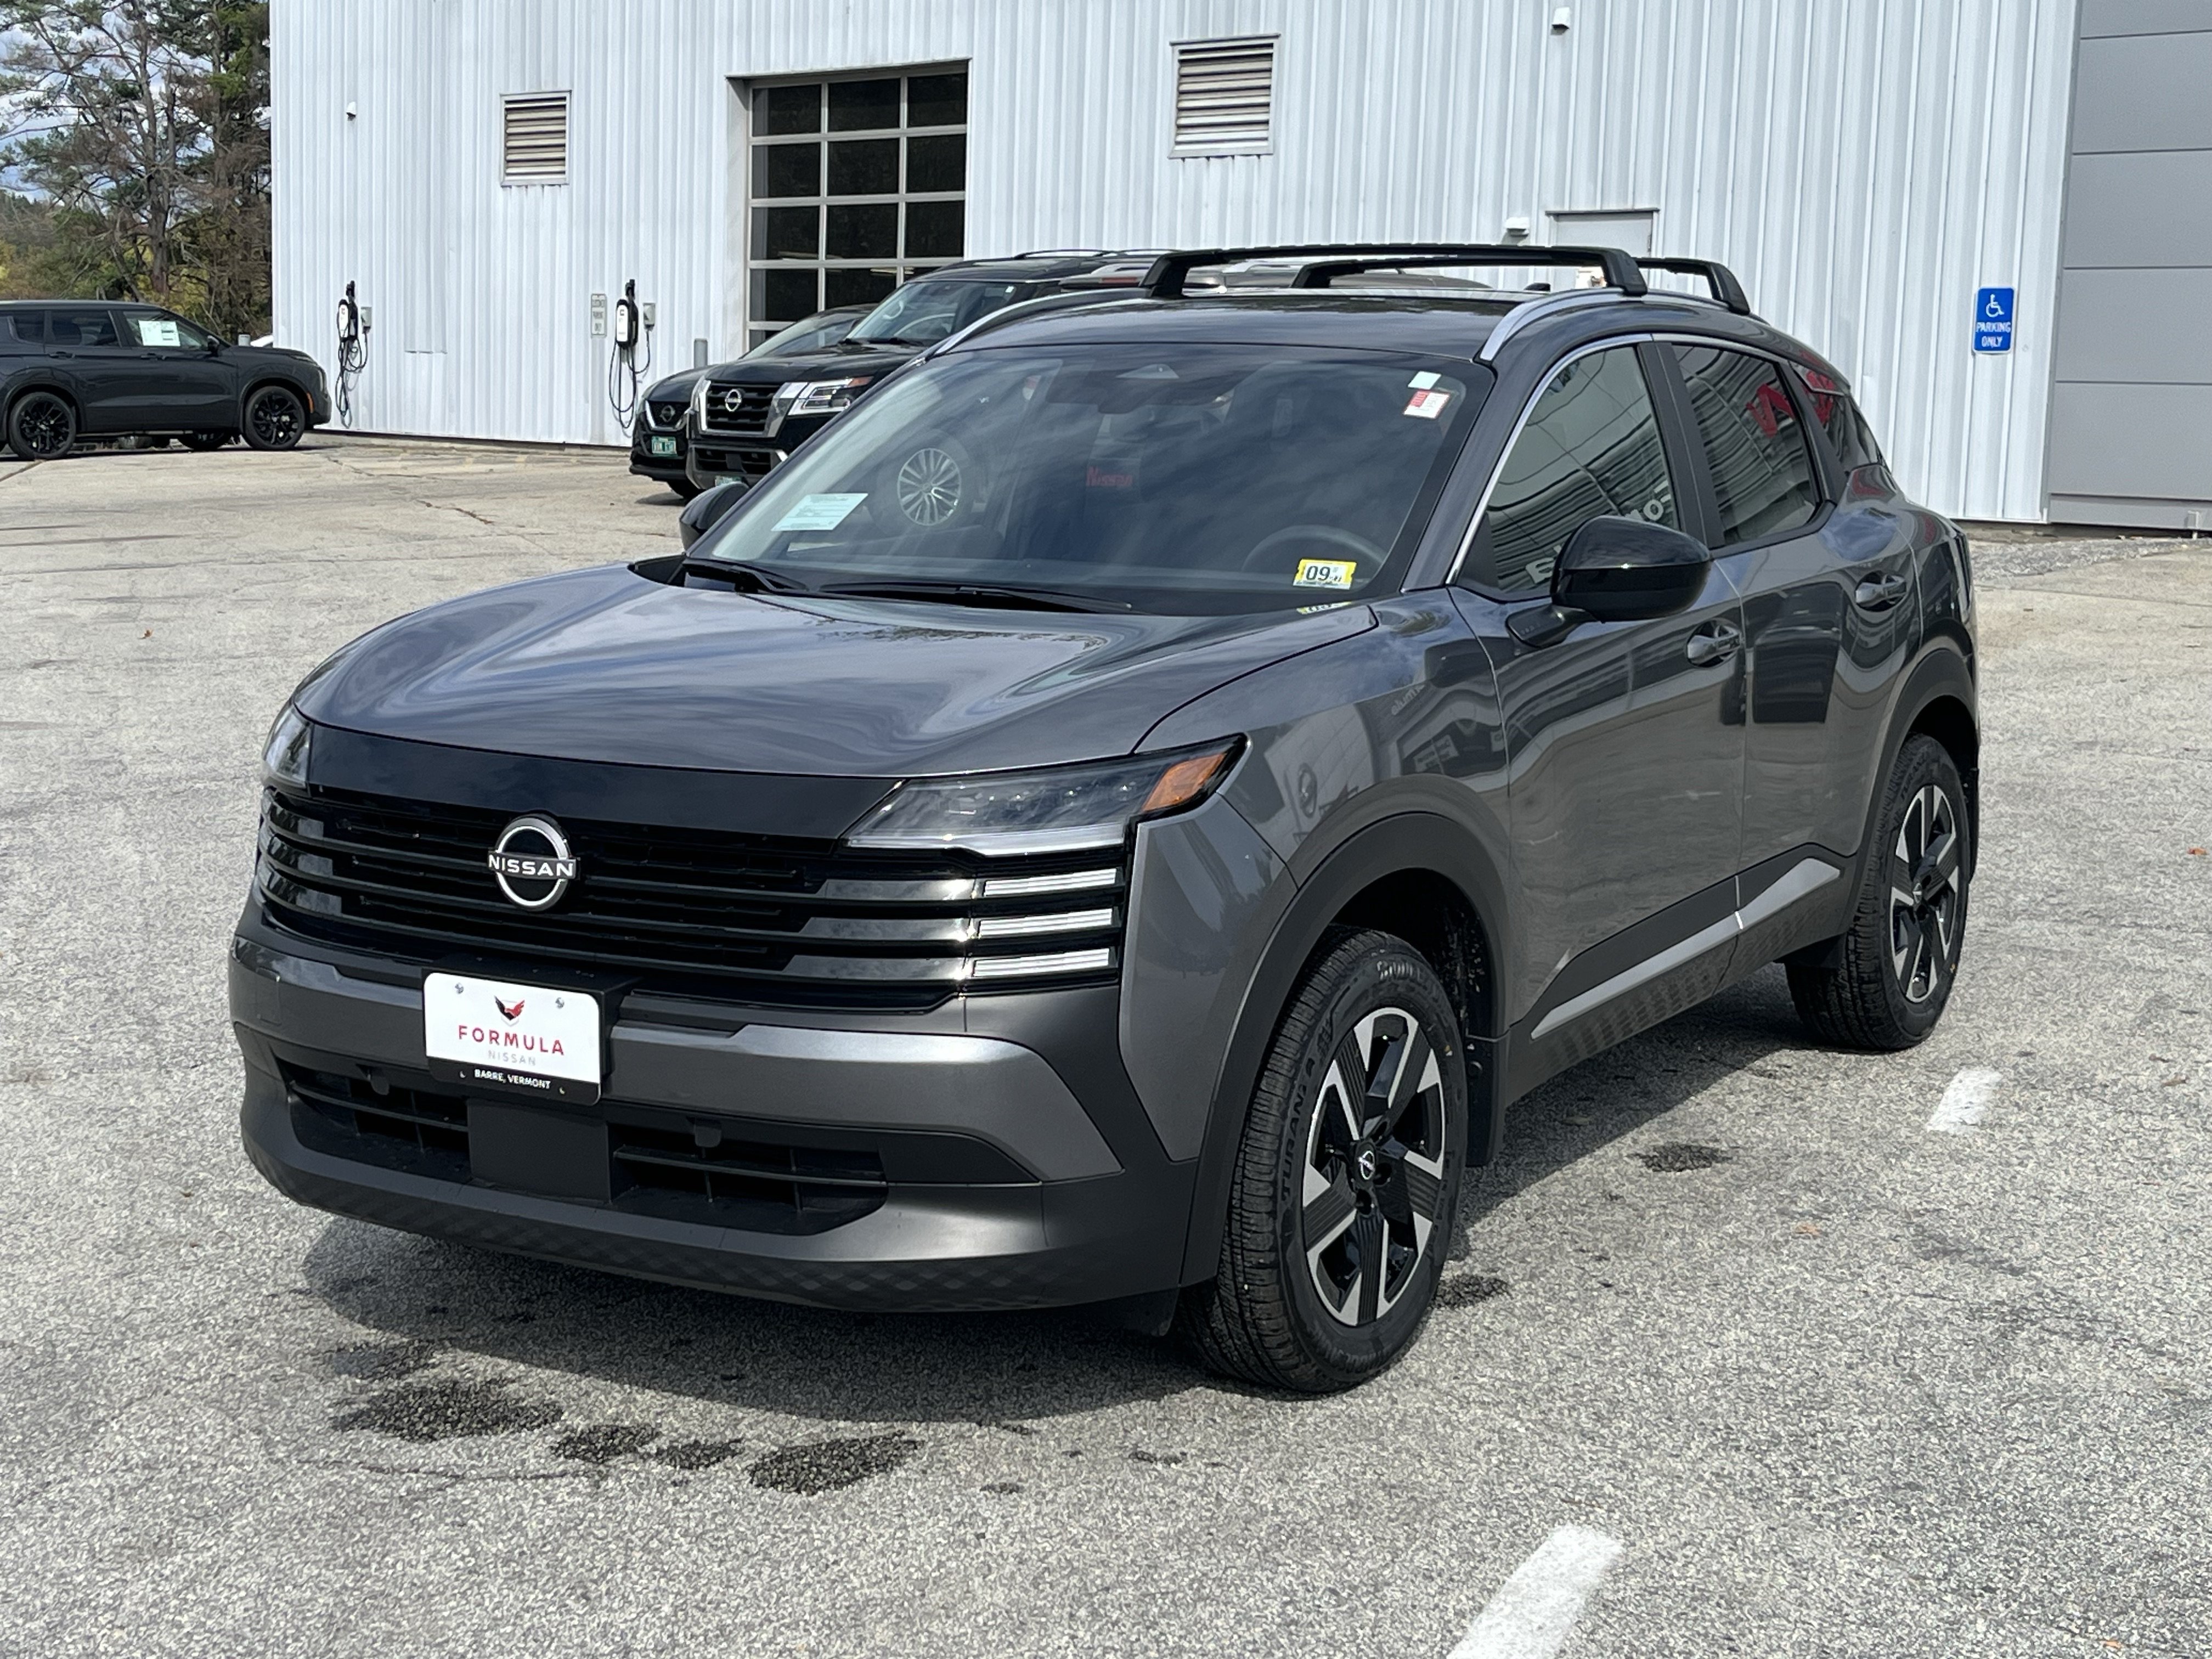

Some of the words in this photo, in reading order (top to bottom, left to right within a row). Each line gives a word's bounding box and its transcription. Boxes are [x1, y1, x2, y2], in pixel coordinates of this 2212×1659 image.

[1976, 321, 2011, 333] PARKING
[1981, 336, 2002, 348] ONLY
[1306, 566, 1331, 582] 09
[488, 854, 574, 877] NISSAN
[458, 1024, 565, 1056] FORMULA
[487, 1049, 537, 1066] NISSAN
[474, 1069, 506, 1084] BARRE,
[507, 1074, 551, 1090] VERMONT
